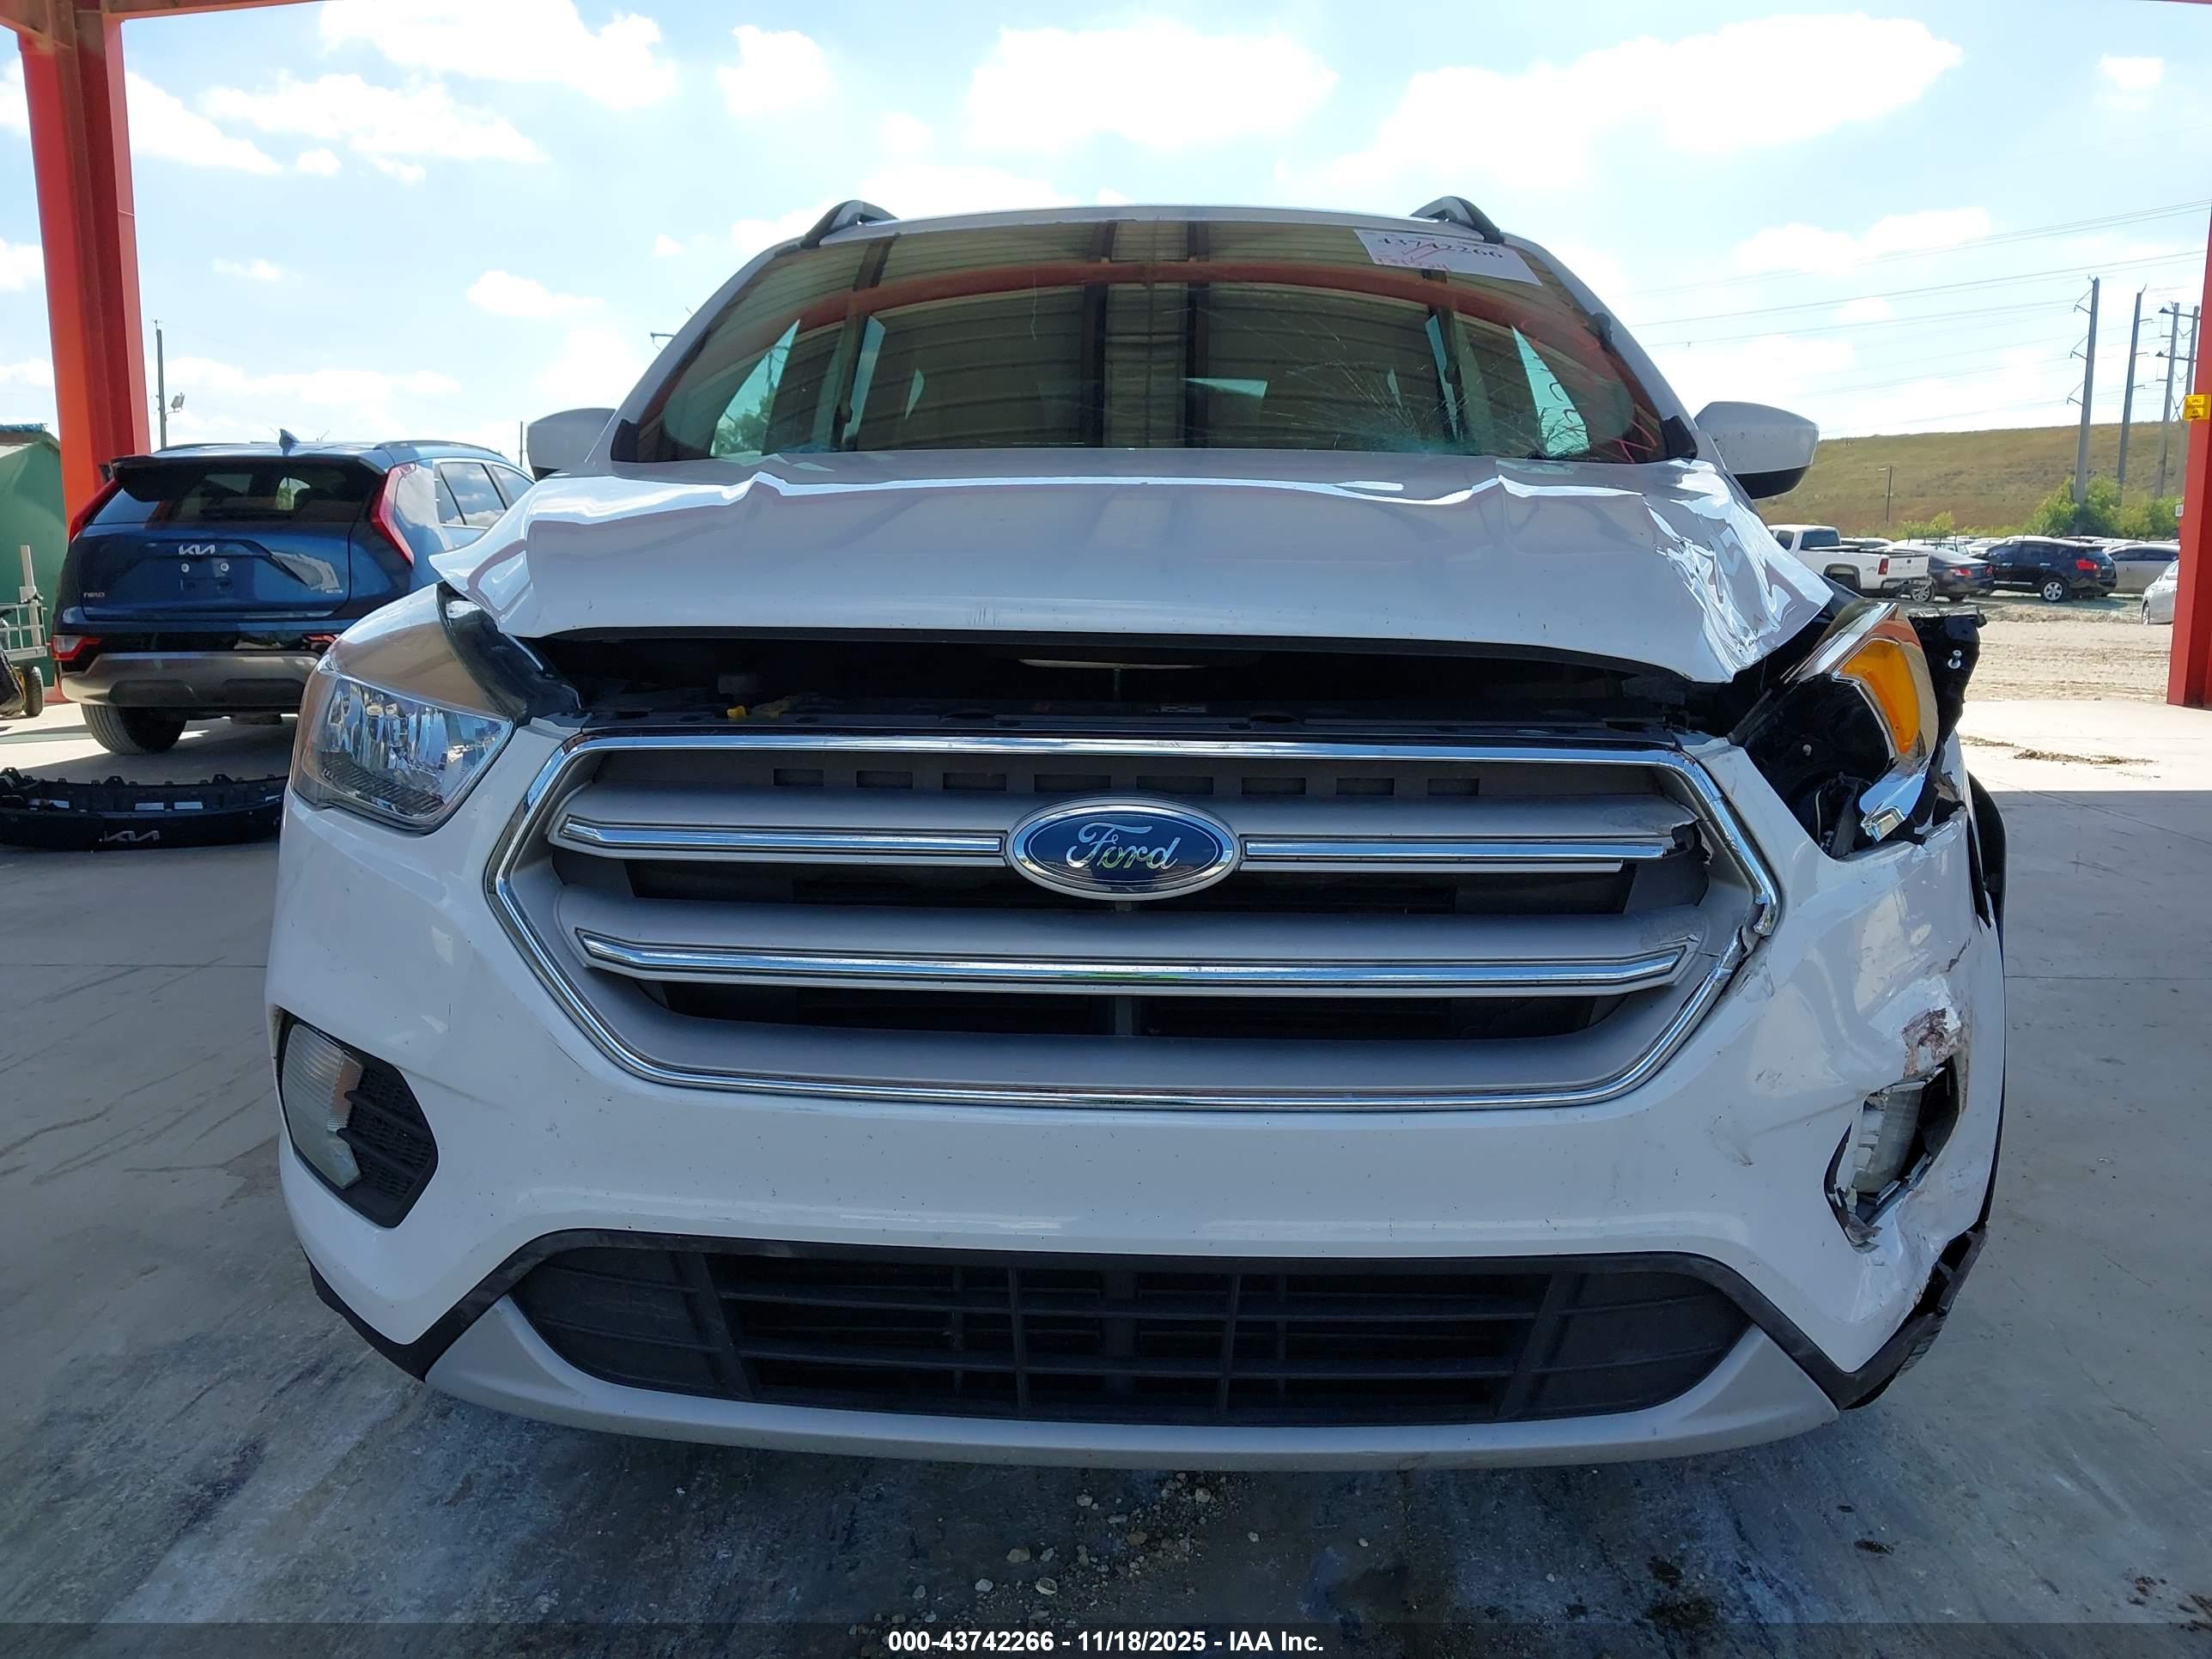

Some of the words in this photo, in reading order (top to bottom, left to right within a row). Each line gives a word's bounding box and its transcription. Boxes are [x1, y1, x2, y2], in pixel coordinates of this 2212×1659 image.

[178, 544, 216, 556] KIA
[103, 830, 161, 842] KIA
[1066, 822, 1181, 870] Ford
